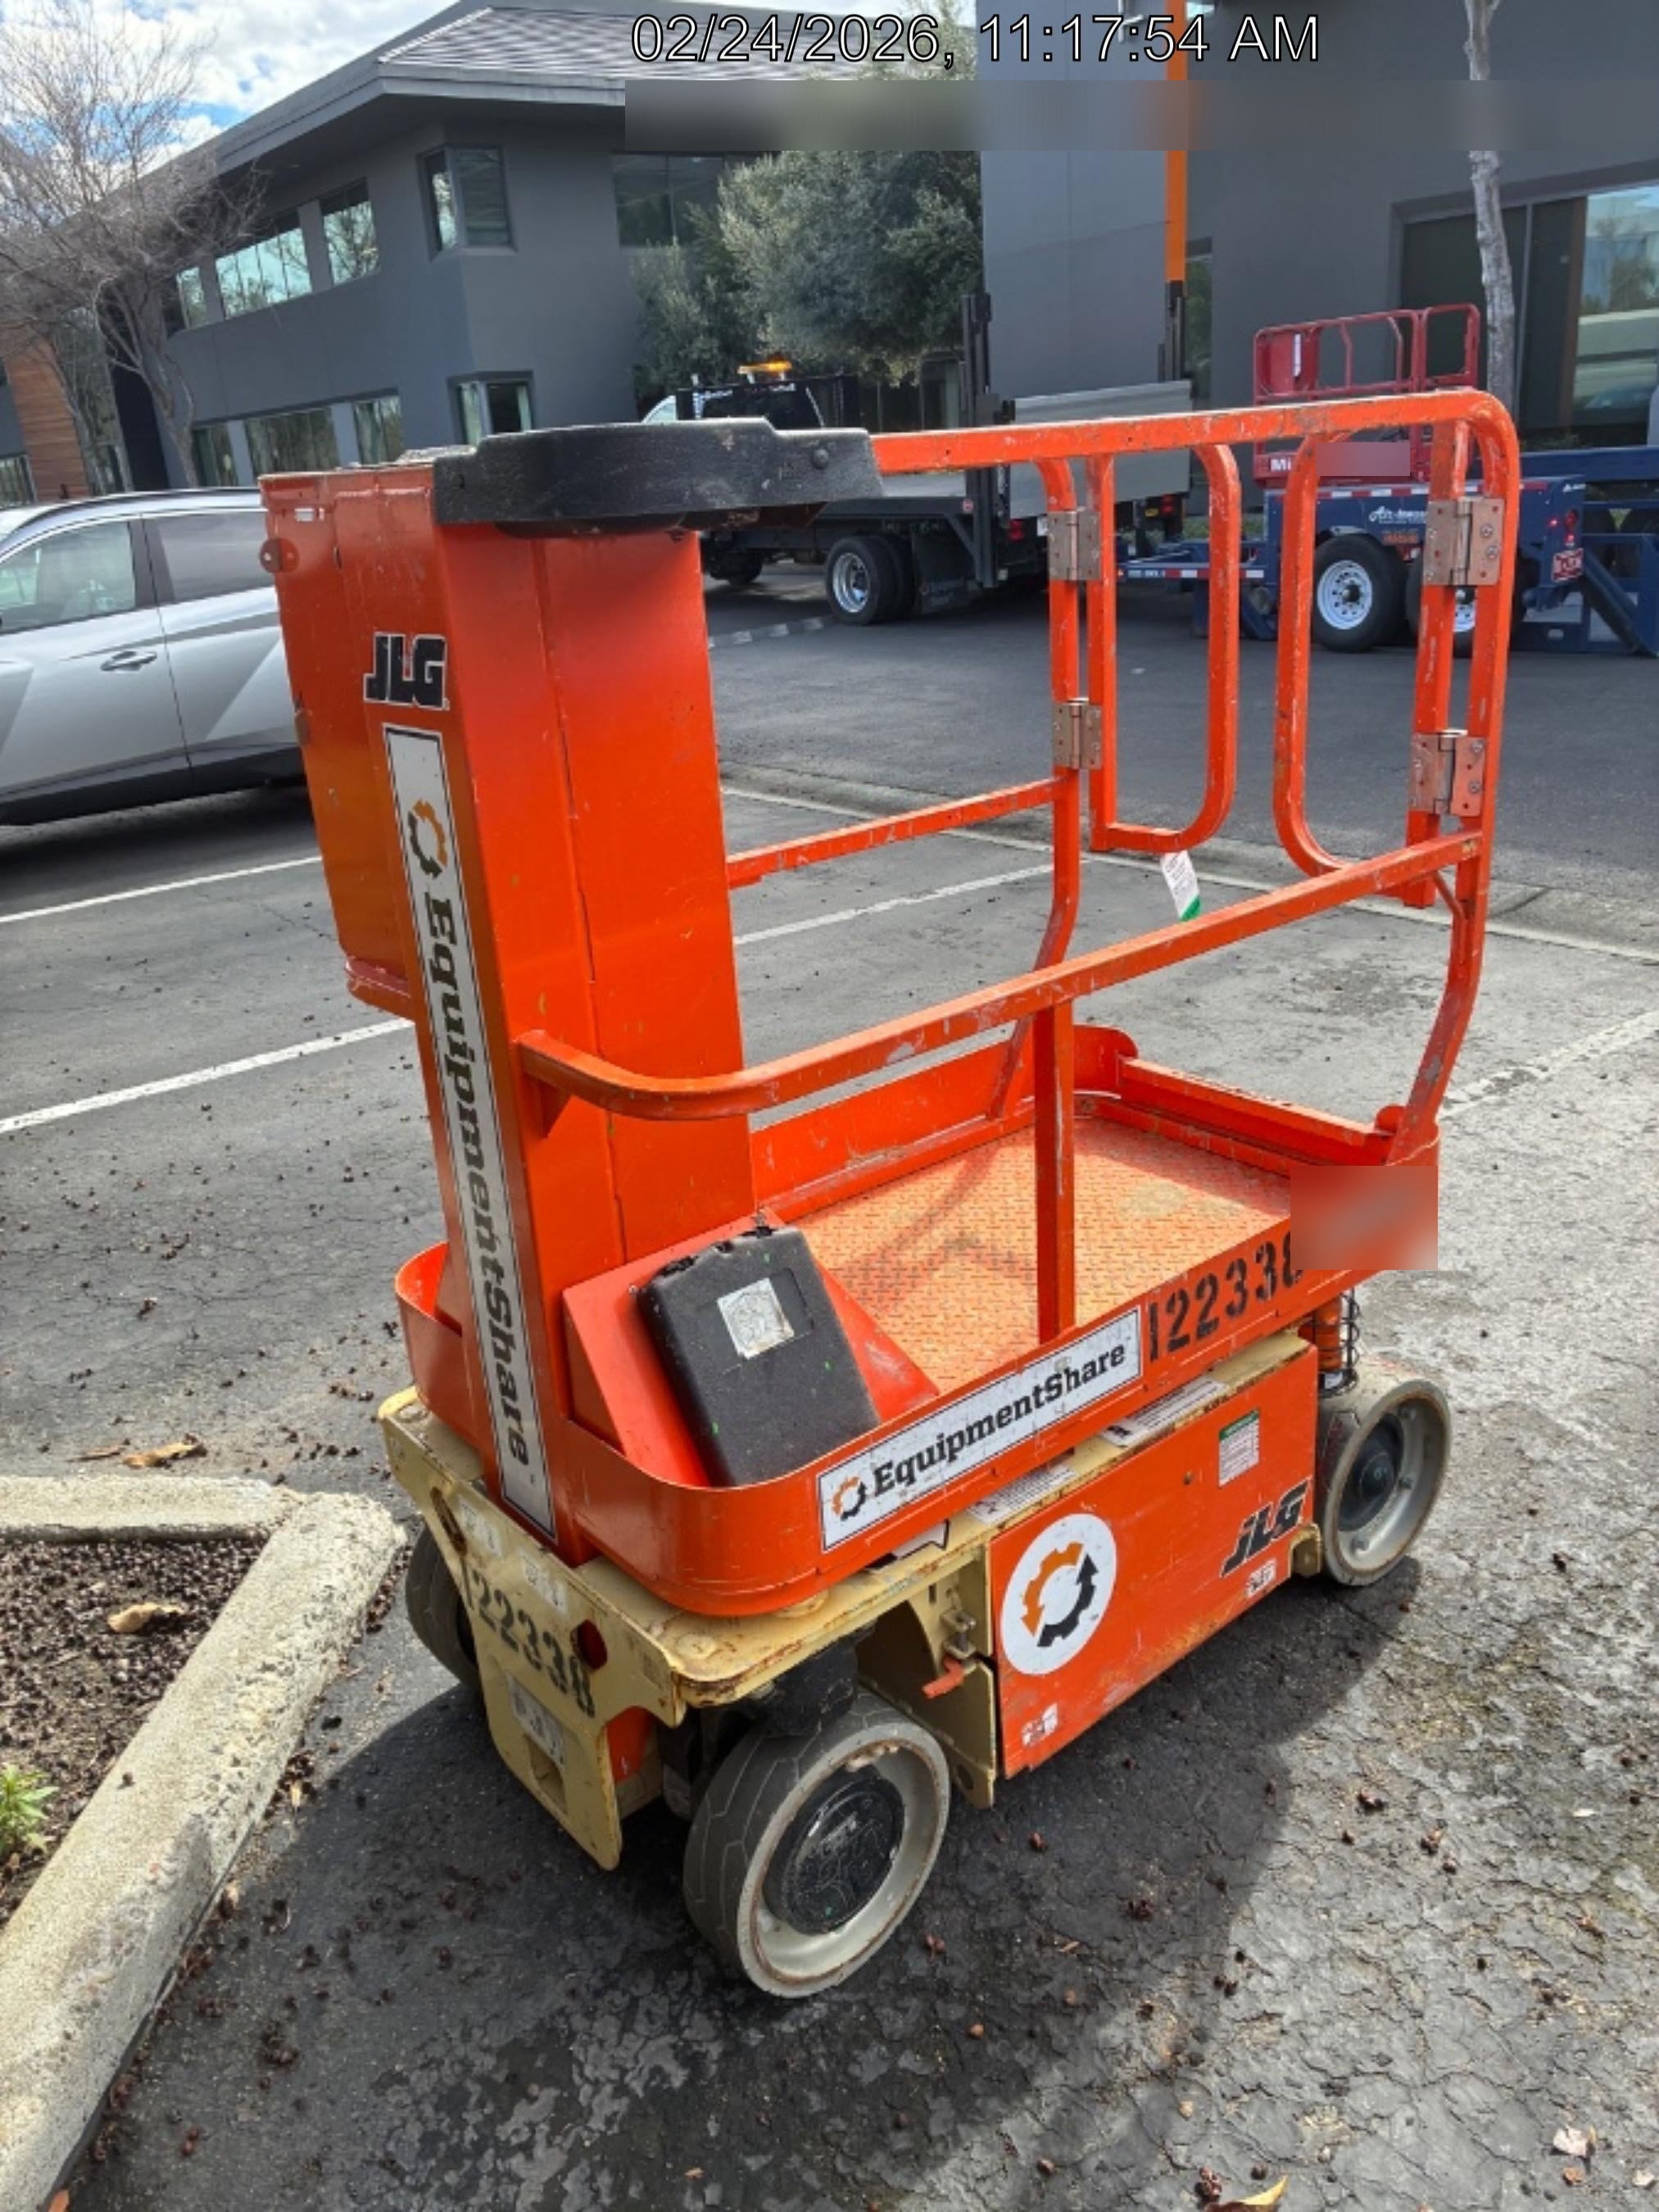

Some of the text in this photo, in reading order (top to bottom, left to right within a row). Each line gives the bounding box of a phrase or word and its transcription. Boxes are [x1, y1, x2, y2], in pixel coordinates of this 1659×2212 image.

[363, 632, 446, 710] JLG
[423, 897, 530, 1466] EquipmentShare
[873, 1341, 1126, 1498] EquipmentShare
[1219, 1475, 1311, 1579] JLG
